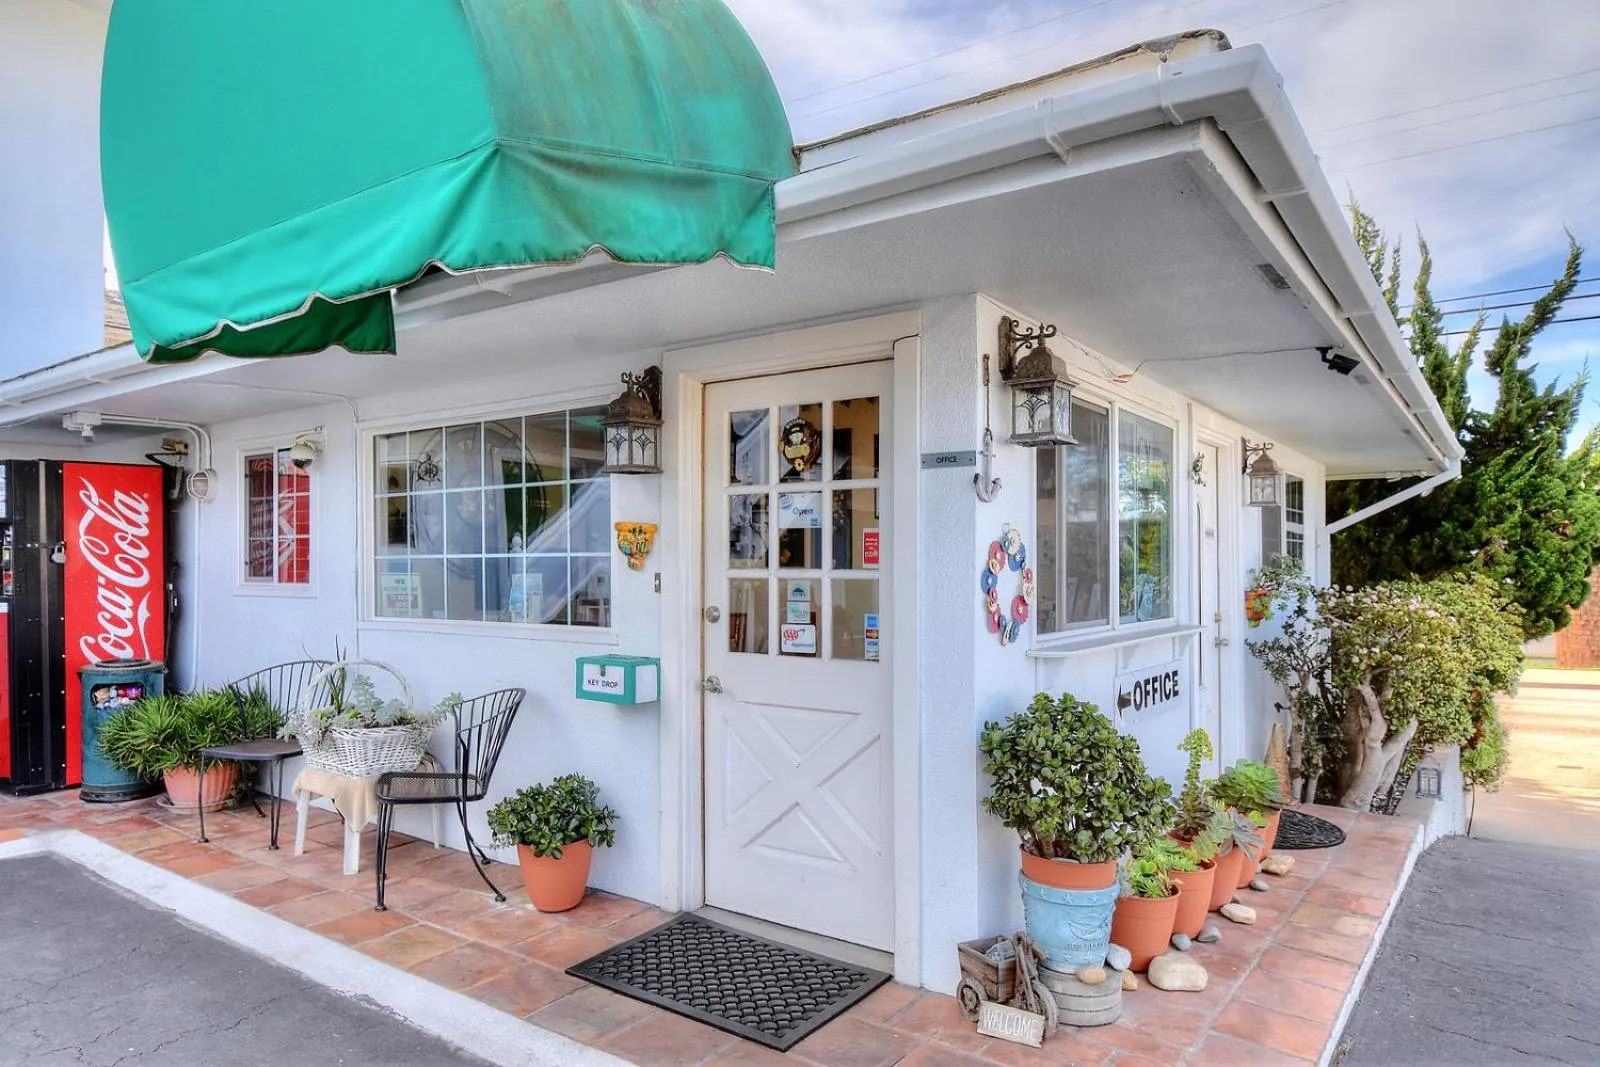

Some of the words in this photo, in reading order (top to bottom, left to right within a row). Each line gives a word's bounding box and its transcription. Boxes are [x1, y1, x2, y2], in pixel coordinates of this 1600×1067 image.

[935, 456, 958, 464] OFFICE
[792, 507, 814, 517] Open
[587, 679, 599, 687] KEY
[601, 680, 619, 689] DROP
[1133, 670, 1180, 712] OFFICE
[983, 1008, 1037, 1040] WELCOME
